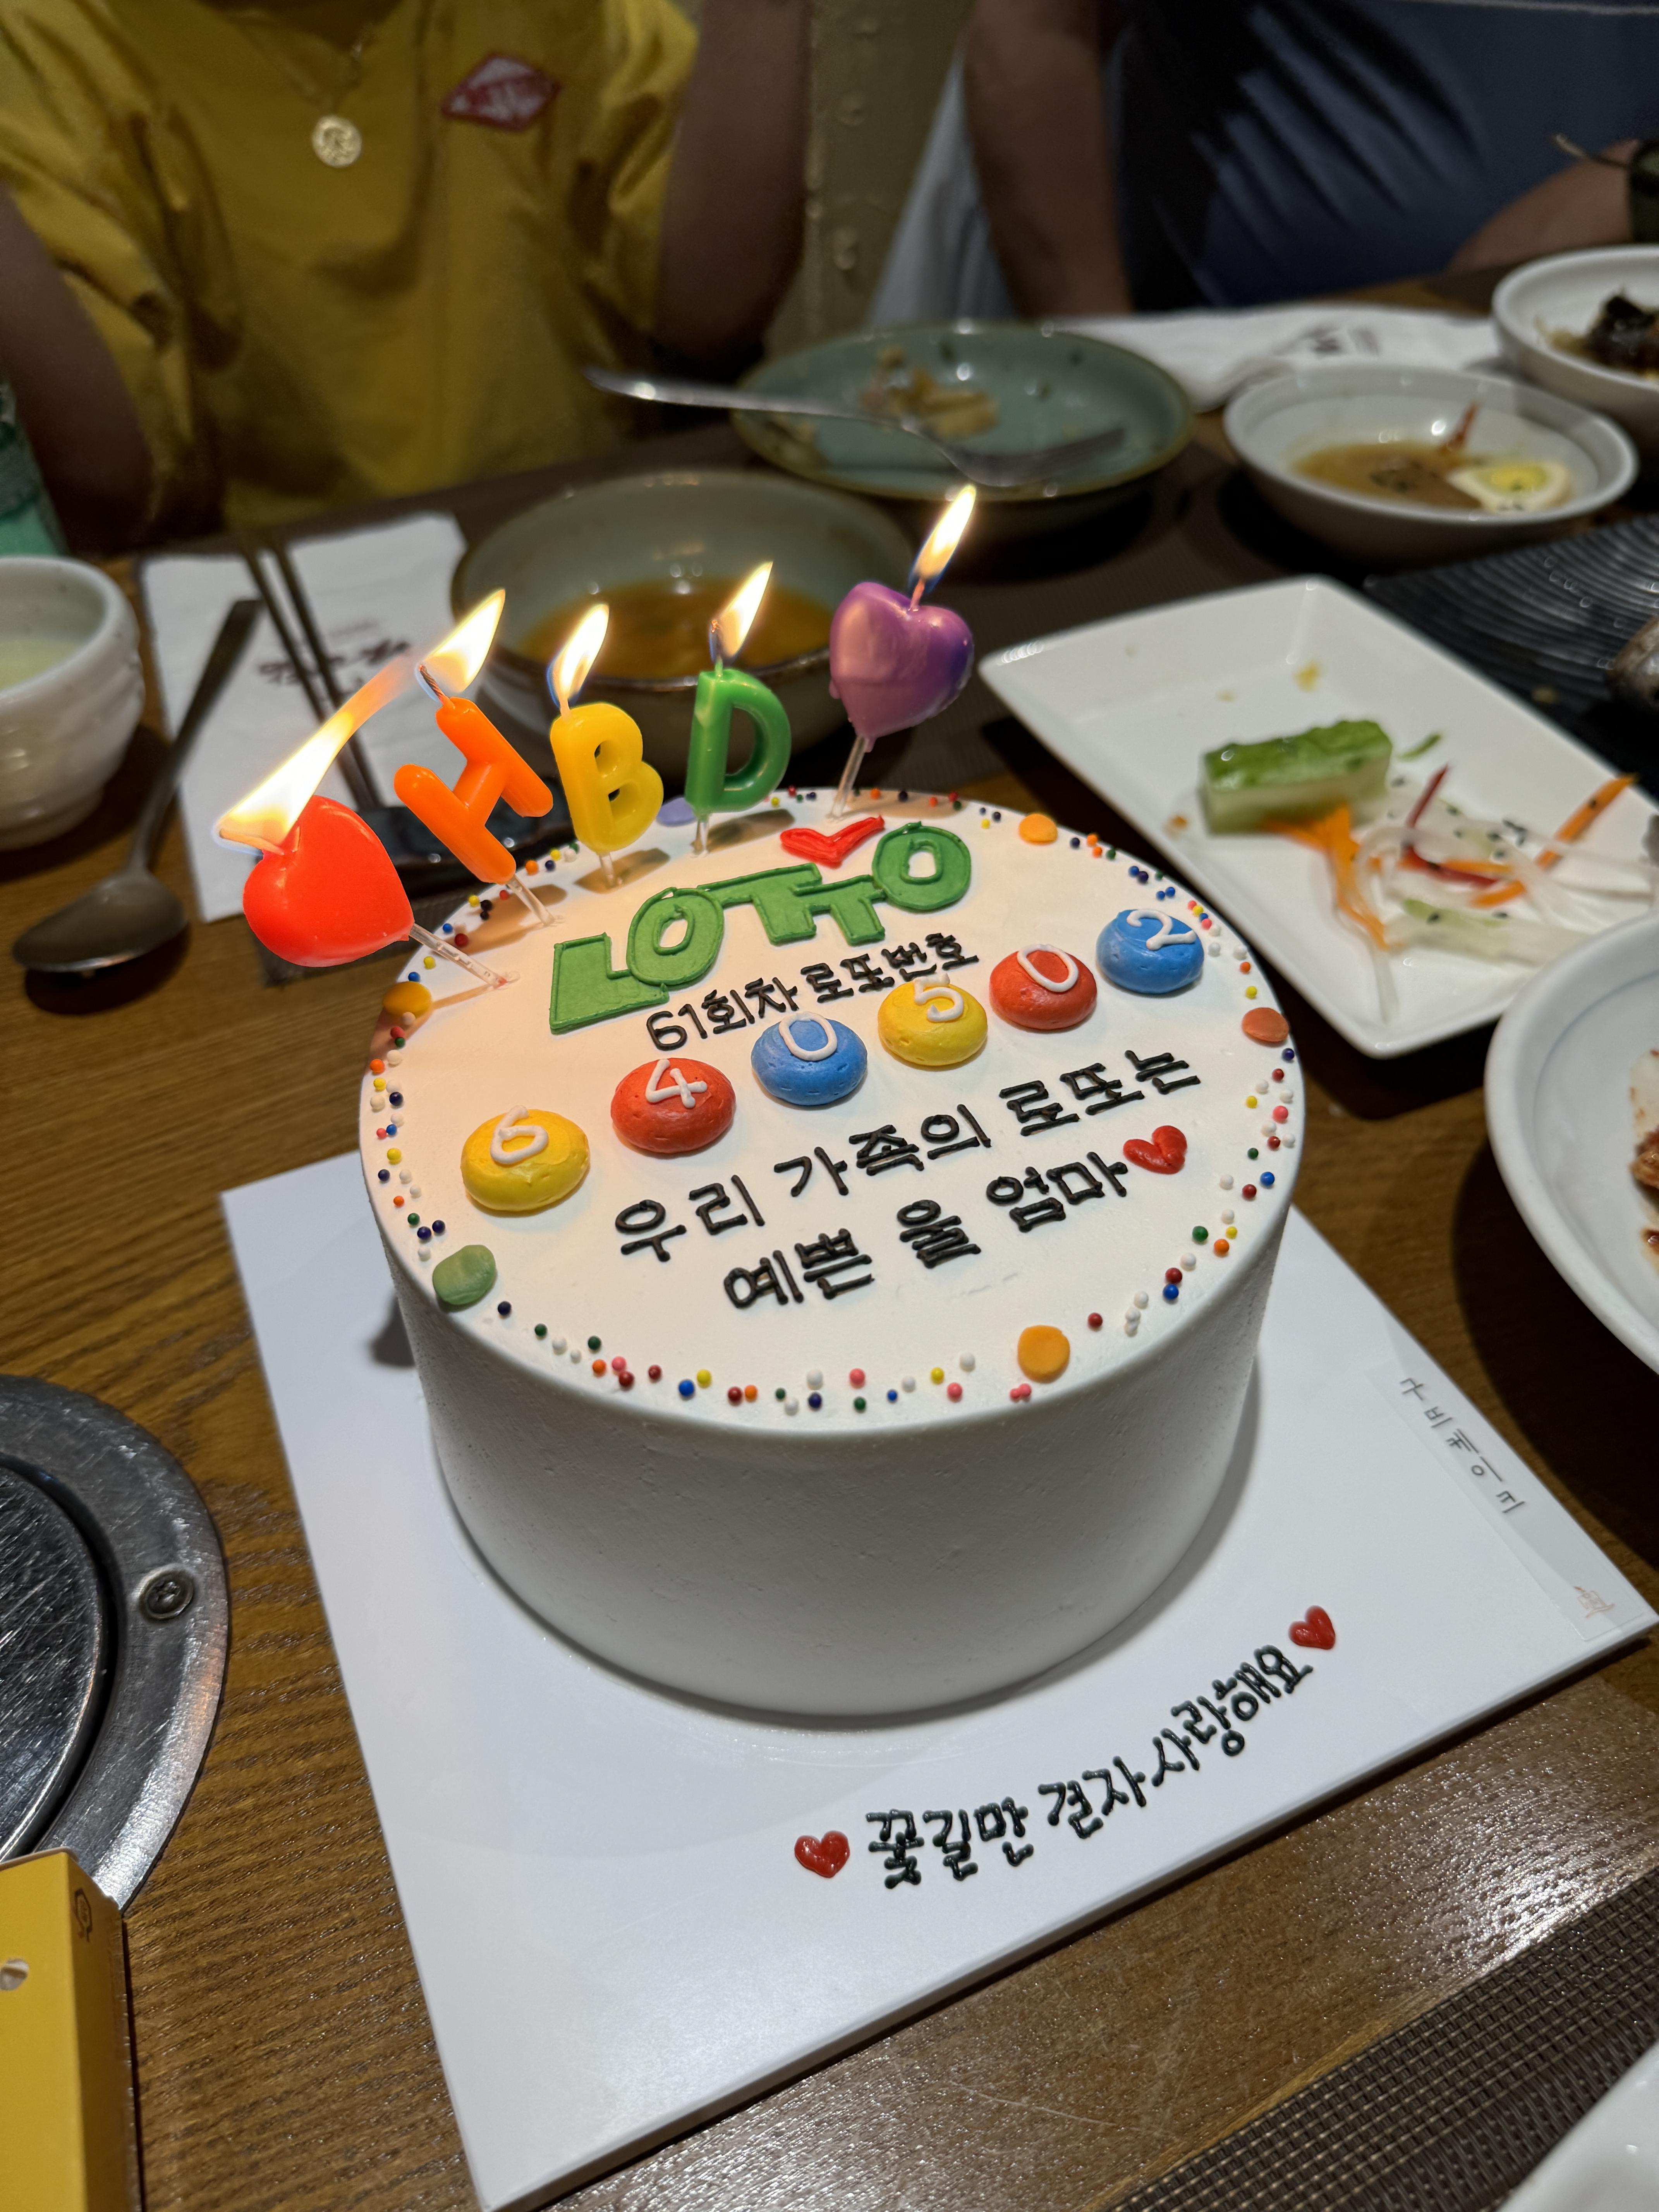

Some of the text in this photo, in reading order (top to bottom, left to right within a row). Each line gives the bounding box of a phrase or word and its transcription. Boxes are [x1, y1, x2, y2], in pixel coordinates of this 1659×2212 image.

[550, 821, 971, 1035] LOTTO
[646, 932, 979, 1051] 61회차 로또번호
[490, 908, 1197, 1165] 6 4 0 5 0 2
[614, 1049, 1201, 1262] 우리 가족의 로또는
[723, 1151, 1128, 1310] 예쁜 울 엄마
[866, 1645, 1314, 1890] 꽃길만 걷자 사랑해요
